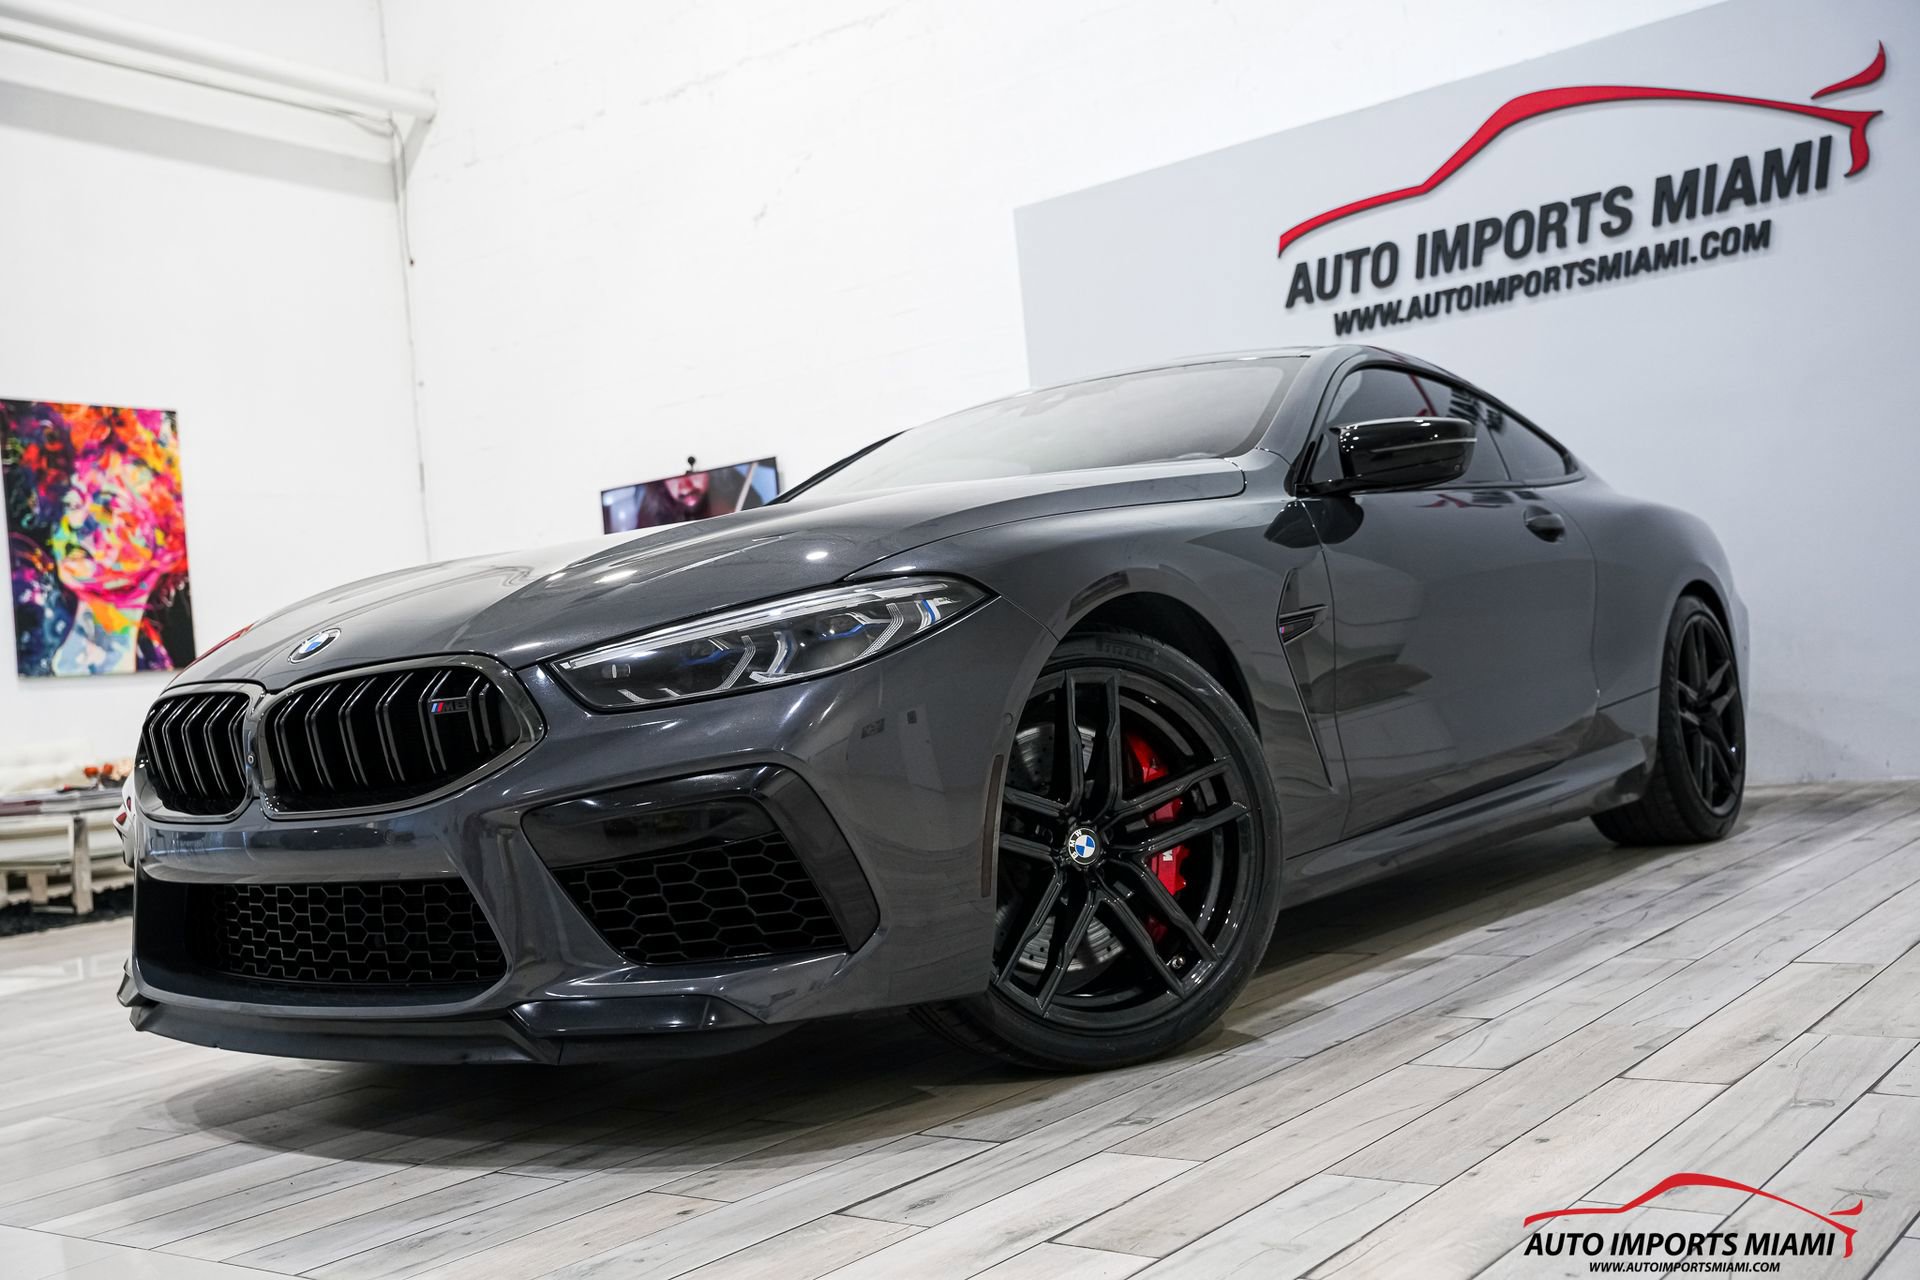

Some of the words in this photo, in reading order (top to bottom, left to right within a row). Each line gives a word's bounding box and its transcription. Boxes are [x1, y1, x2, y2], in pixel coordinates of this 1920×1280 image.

[1285, 242, 1398, 308] AUTO
[1415, 186, 1633, 279] IMPORTS
[1651, 135, 1833, 227] MIAMI
[1333, 220, 1772, 336] WWW.AUTOIMPORTSMIAMI.COM
